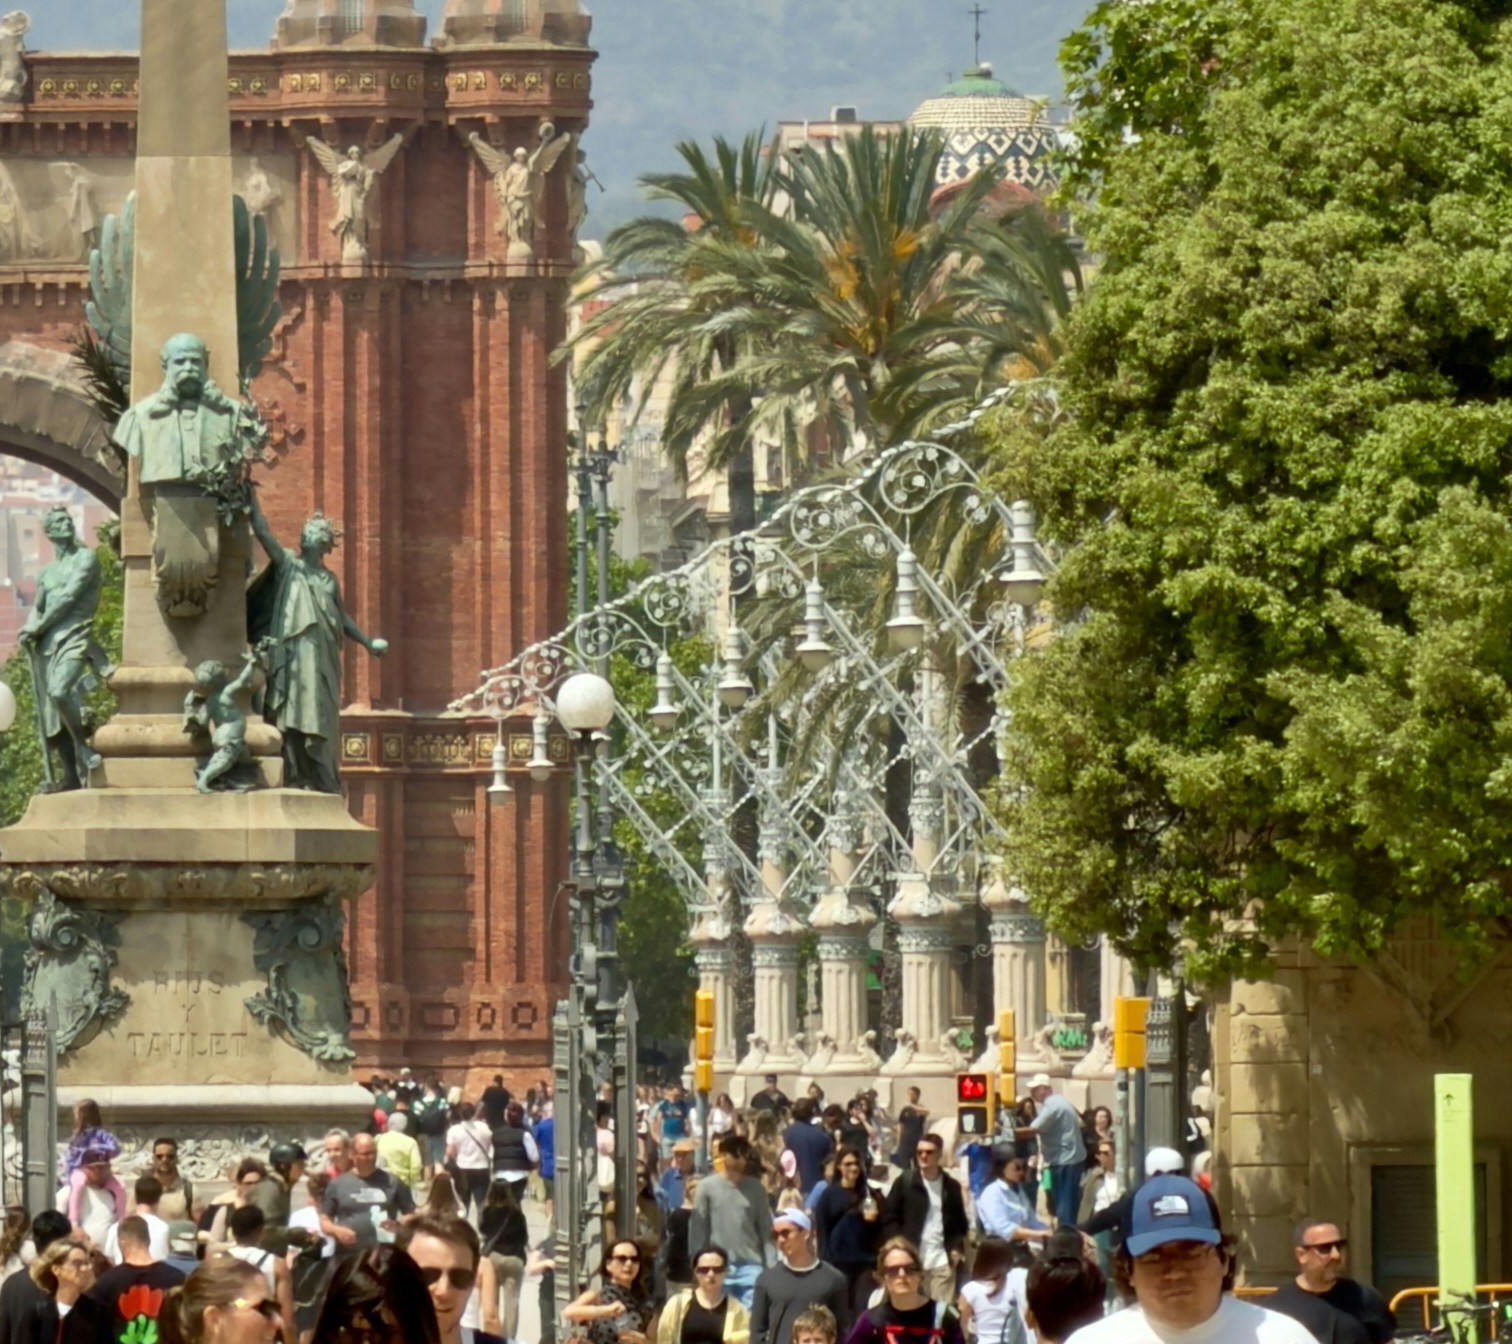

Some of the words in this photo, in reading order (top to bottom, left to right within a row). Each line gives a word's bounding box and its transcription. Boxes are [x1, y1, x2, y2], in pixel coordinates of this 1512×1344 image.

[153, 969, 225, 995] RIUS
[181, 1003, 195, 1024] Y
[128, 1031, 248, 1057] TAULET
